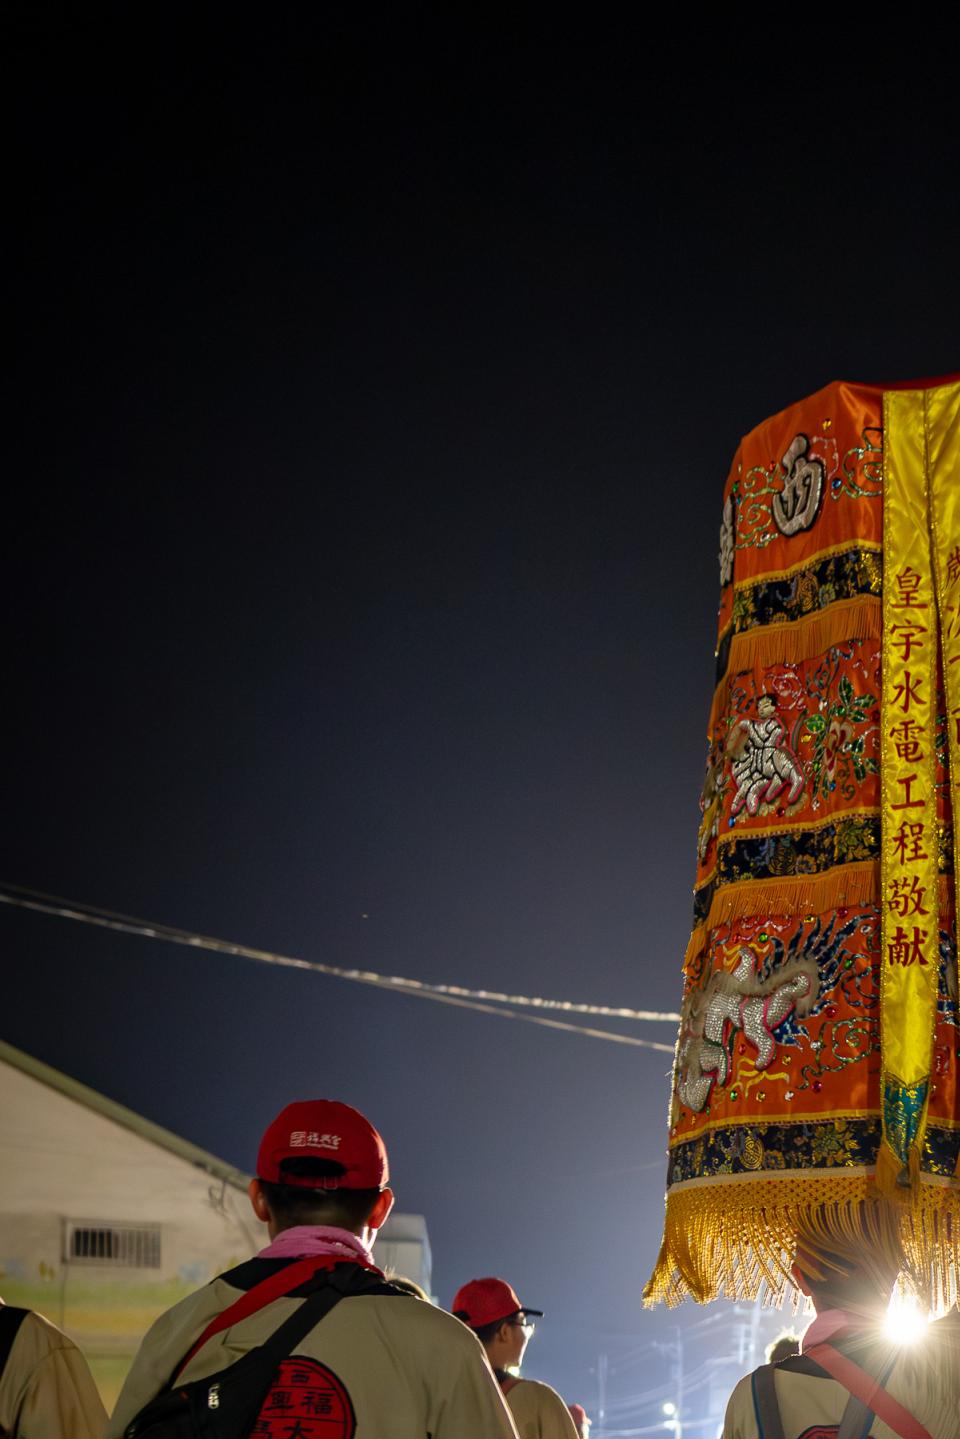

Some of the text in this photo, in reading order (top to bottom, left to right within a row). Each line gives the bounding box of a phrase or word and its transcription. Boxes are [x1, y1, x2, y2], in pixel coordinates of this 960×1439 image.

[887, 566, 930, 968] 皇宇水電工程敬献
